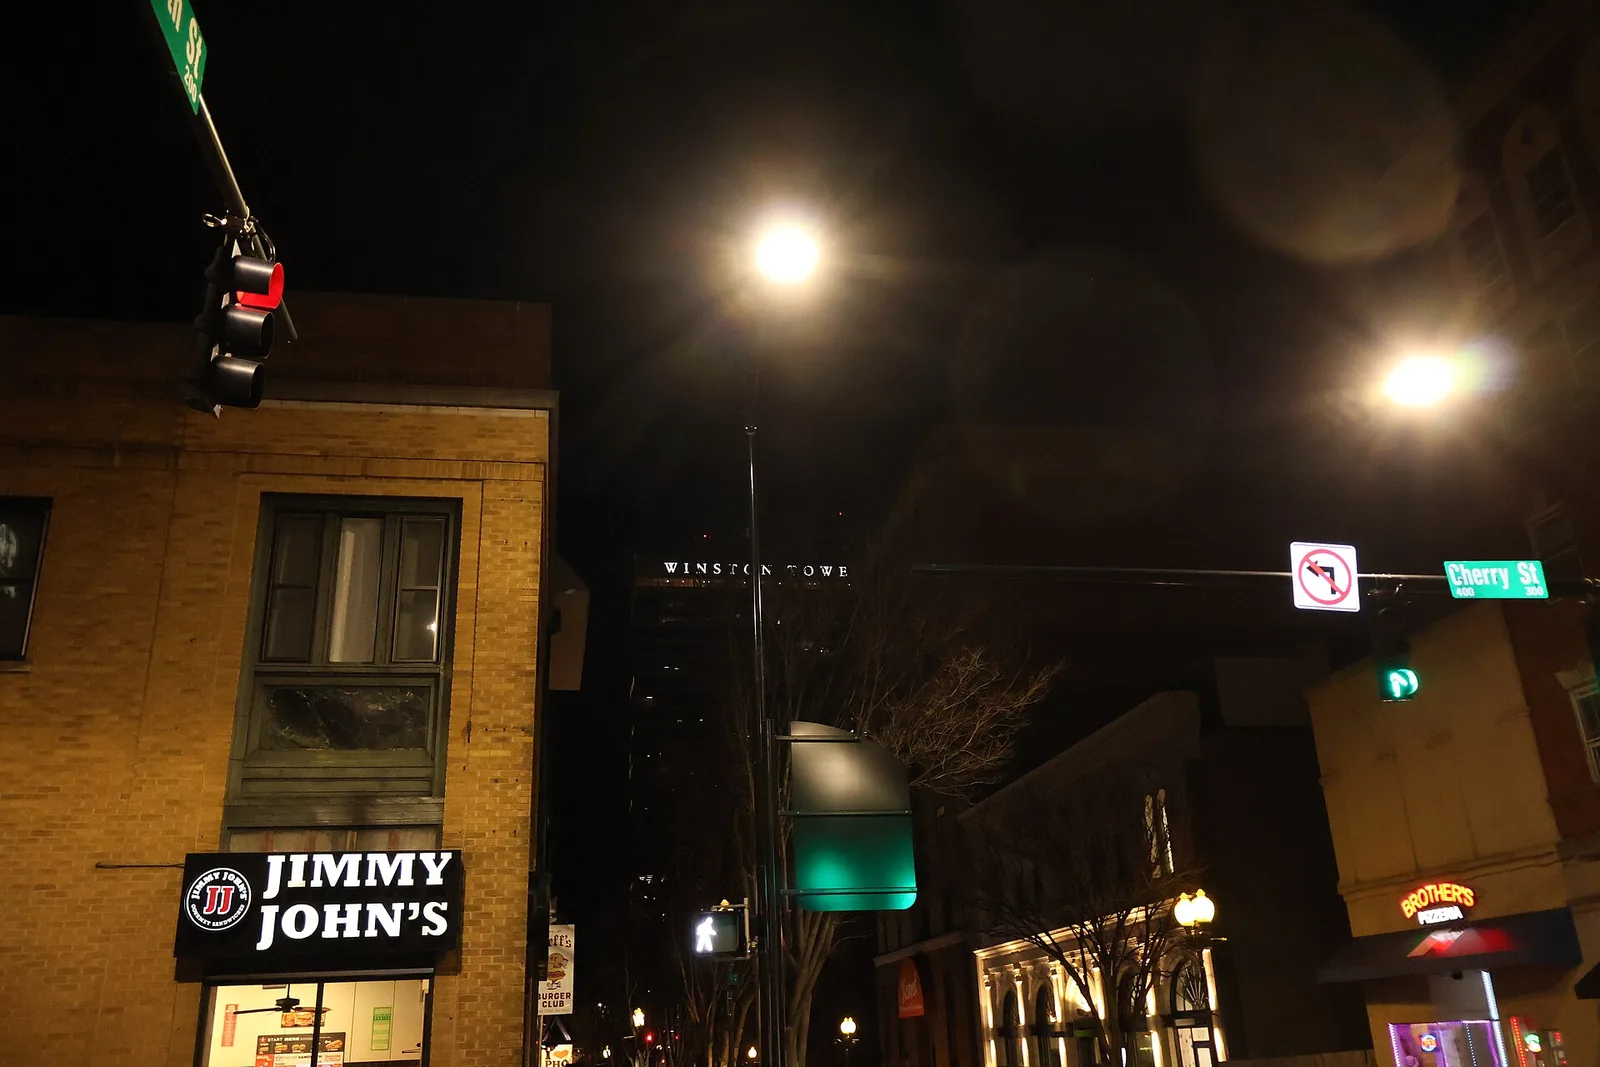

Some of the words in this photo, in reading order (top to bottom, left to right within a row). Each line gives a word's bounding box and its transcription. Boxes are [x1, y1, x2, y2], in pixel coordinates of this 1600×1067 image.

[185, 17, 203, 80] St
[184, 64, 198, 104] 200
[1448, 563, 1510, 590] Cherry
[1517, 562, 1541, 585] St
[1455, 587, 1475, 597] 400
[1524, 586, 1544, 597] 300
[191, 872, 221, 900] JIMMY
[262, 852, 453, 899] JIMMY
[203, 885, 235, 915] JJ
[1400, 883, 1475, 919] BROTHER'S
[255, 901, 449, 951] JOHN'S
[548, 934, 572, 948] eff's
[537, 992, 571, 1000] BURGER
[542, 1000, 565, 1008] CLUB
